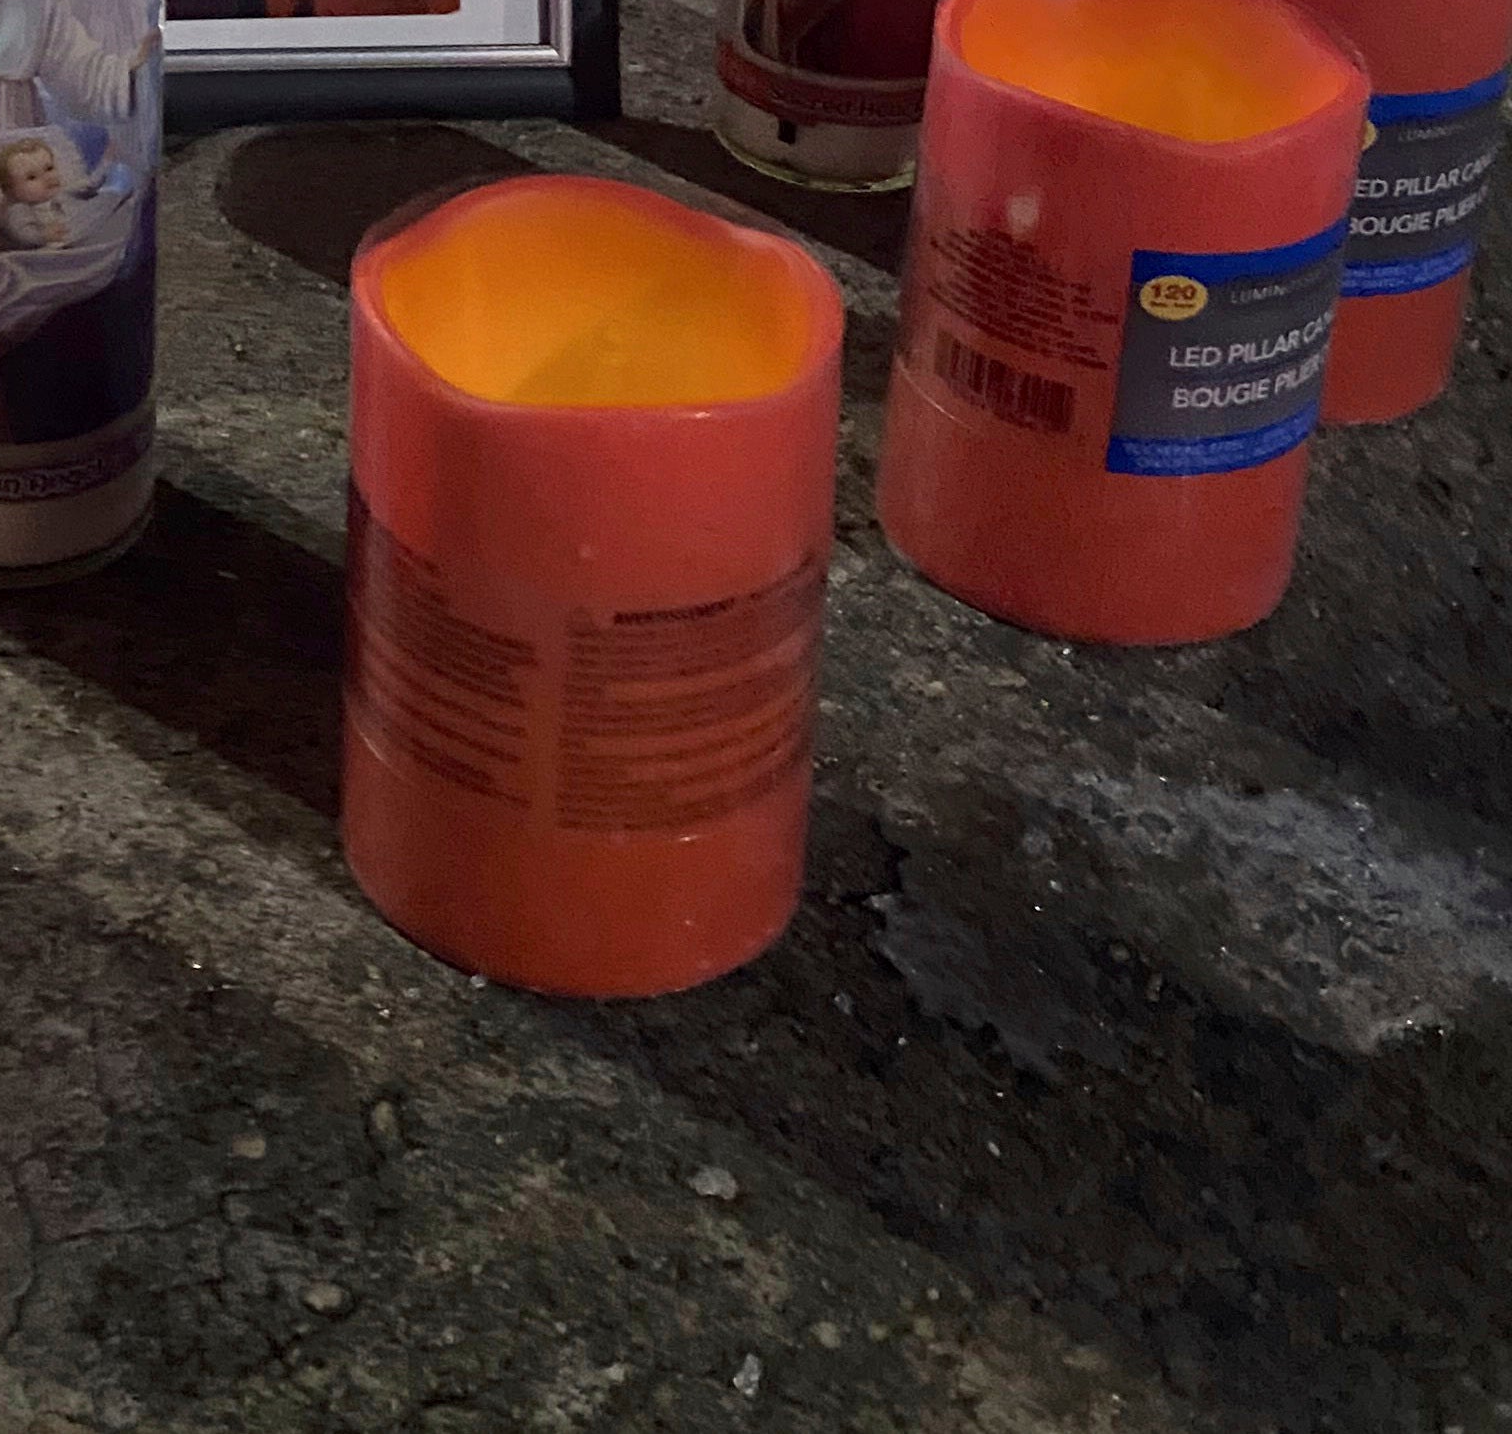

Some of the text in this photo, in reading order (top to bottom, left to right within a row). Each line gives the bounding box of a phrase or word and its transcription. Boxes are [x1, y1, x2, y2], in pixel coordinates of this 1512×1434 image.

[1355, 179, 1388, 198] ED
[1394, 168, 1460, 197] PILLAR
[1150, 283, 1197, 302] 120
[1170, 346, 1221, 367] LED
[1228, 329, 1300, 364] PILLAR
[1172, 378, 1272, 408] BOUGIE
